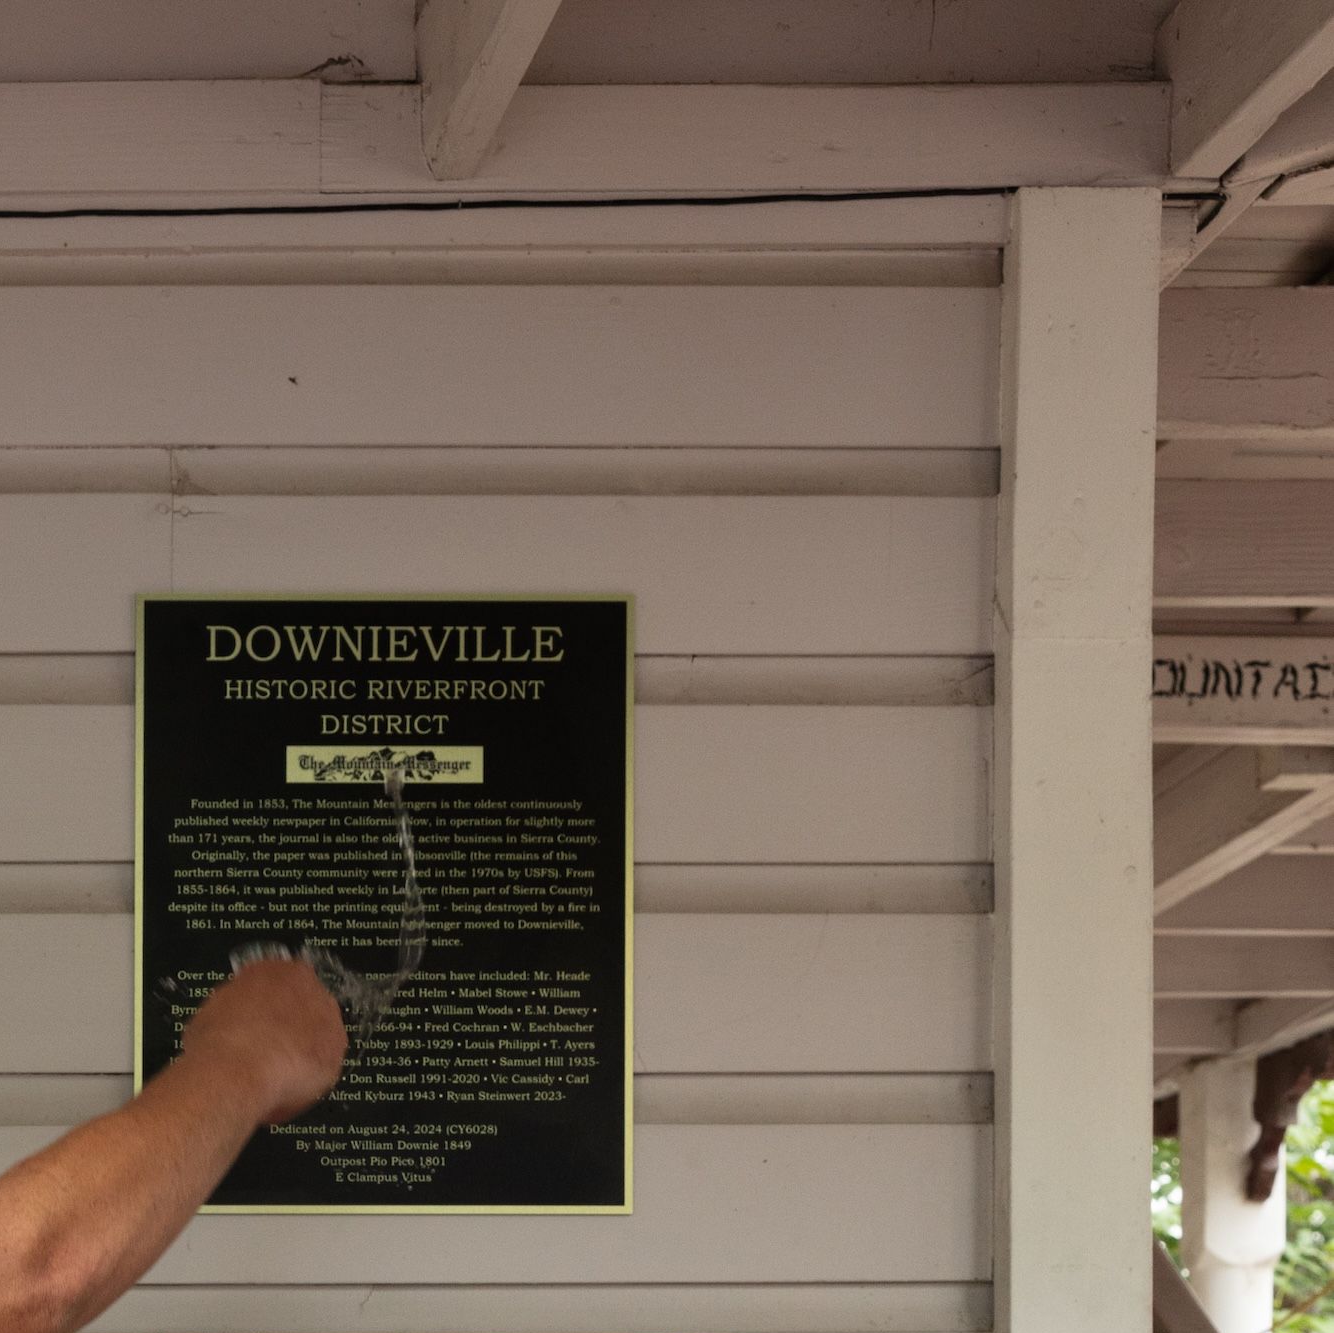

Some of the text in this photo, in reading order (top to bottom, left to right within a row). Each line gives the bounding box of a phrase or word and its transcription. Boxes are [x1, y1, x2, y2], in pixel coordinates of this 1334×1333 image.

[205, 624, 565, 662] DOWNIEVILLE
[224, 679, 545, 700] HISTORIC RIVERFRONT
[320, 714, 450, 735] DISTRICT
[298, 755, 472, 774] The Mountain Messenger
[190, 798, 583, 812] Founded in 1853, The Mountain Mesengers is the oldest continuously
[349, 1073, 590, 1087] Don Russell 1991-2020 Vic Cassidy Carl
[328, 1090, 567, 1104] Alfred Kyburz 1943 Ryan Steinwert 2023-
[270, 1123, 327, 1135] Dedicated
[329, 1126, 345, 1135] on
[347, 1124, 389, 1137] August
[391, 1123, 410, 1135] 24,
[413, 1123, 443, 1135] 2024
[295, 1139, 472, 1153] By Major William Downie 1849
[320, 1155, 446, 1169] Outpost Pio Pico 1801
[335, 1171, 434, 1185] E Clampus Vitus
